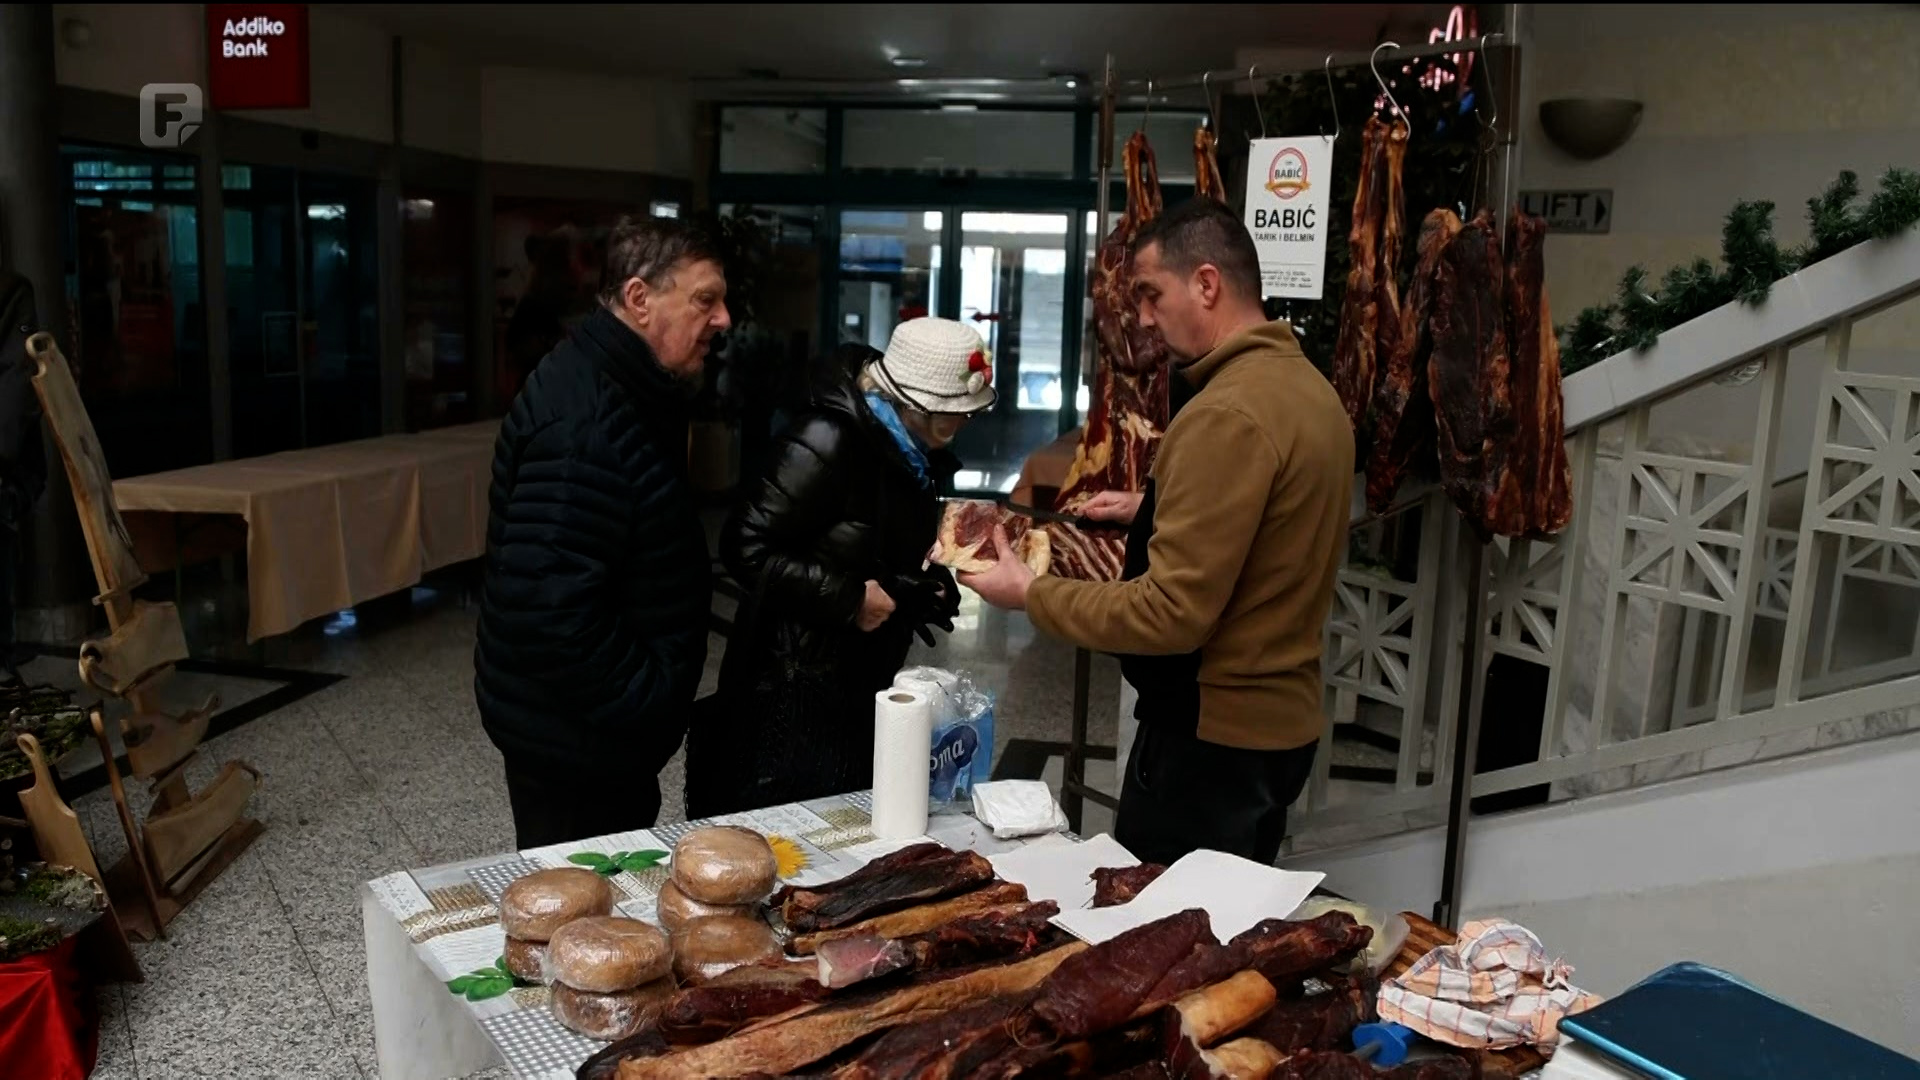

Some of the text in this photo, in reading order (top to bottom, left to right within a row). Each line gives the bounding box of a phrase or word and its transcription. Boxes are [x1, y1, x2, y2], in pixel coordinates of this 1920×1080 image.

[223, 17, 286, 37] Addiko
[222, 38, 268, 57] Bank
[1275, 167, 1302, 178] BABIĆ
[1525, 193, 1589, 216] LIFT
[1255, 203, 1316, 229] BABIĆ
[1255, 232, 1277, 241] TARIK
[1284, 233, 1315, 242] BELMIN
